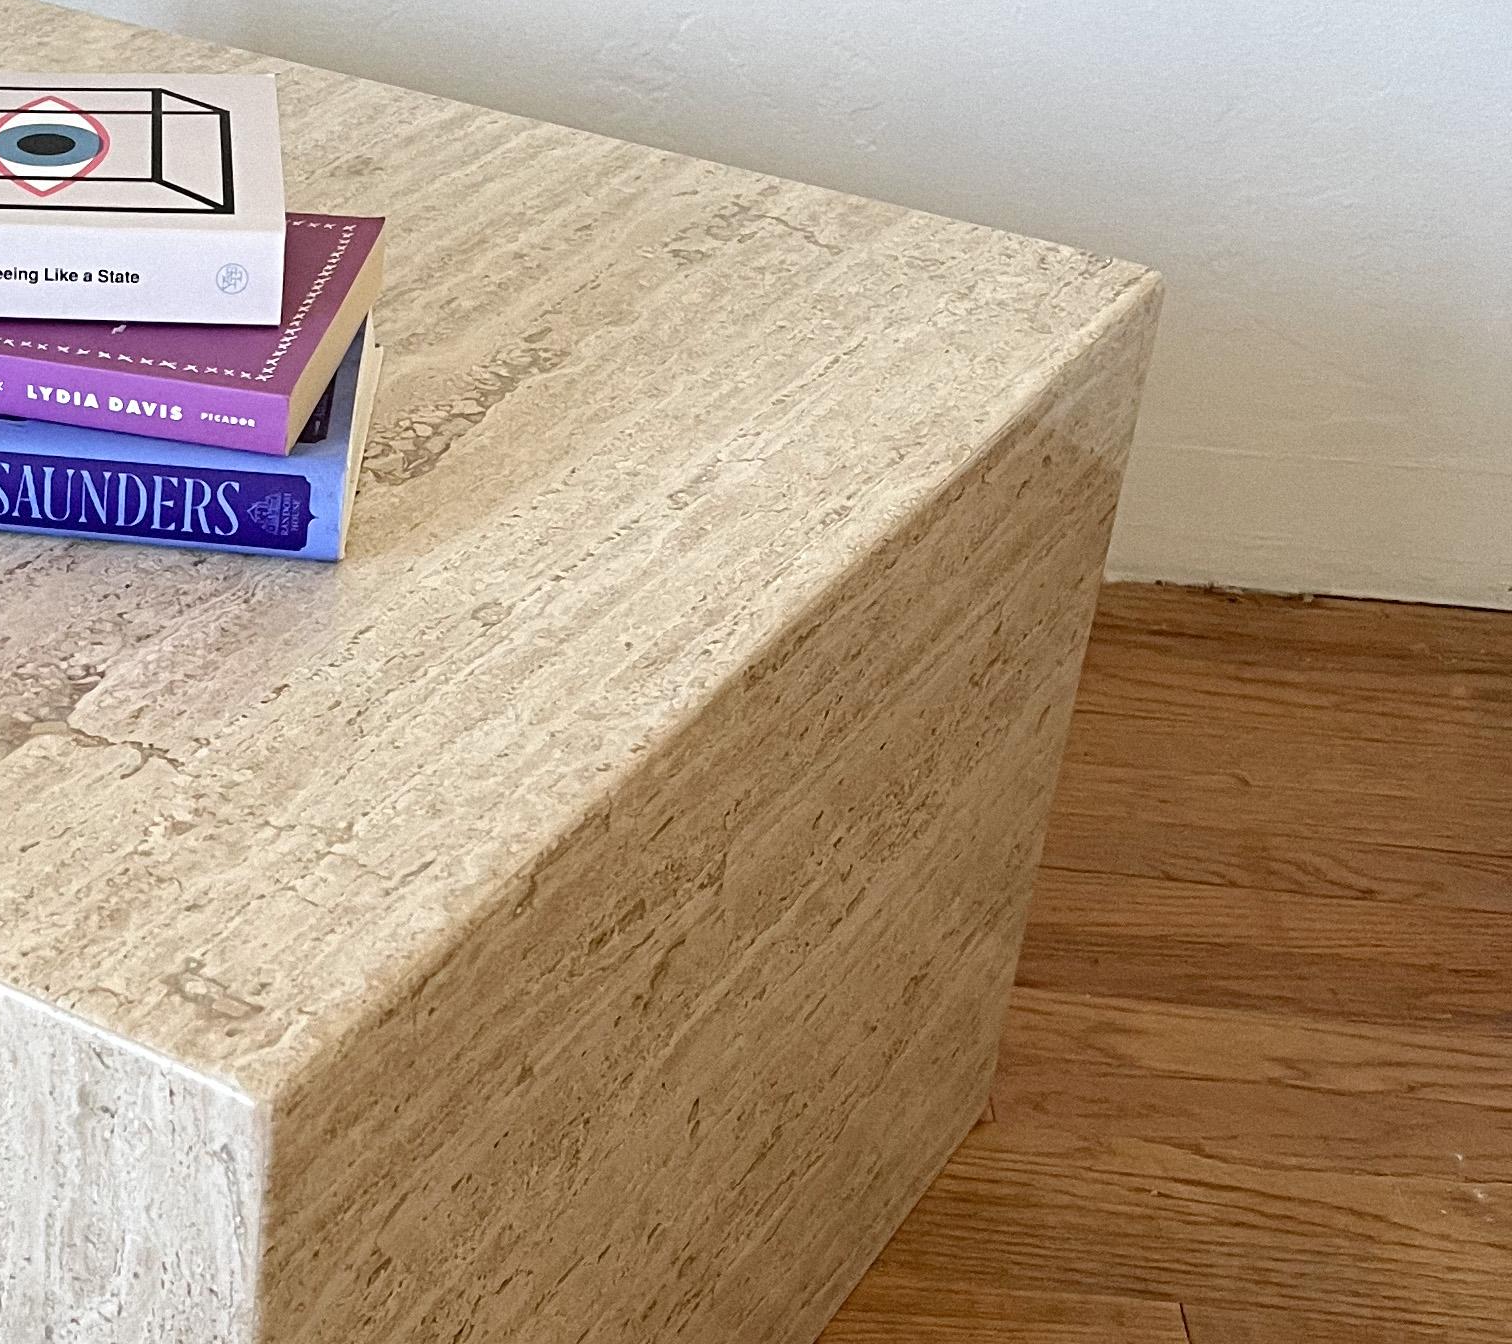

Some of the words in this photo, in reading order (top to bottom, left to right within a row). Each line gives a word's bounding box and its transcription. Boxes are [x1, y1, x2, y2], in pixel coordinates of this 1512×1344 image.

[44, 268, 78, 282] Like
[82, 271, 93, 282] a
[98, 269, 140, 283] State
[26, 384, 99, 409] LYDIA
[108, 396, 184, 421] DAVIS
[200, 412, 256, 428] PICADOR
[280, 492, 292, 536] RANDOM
